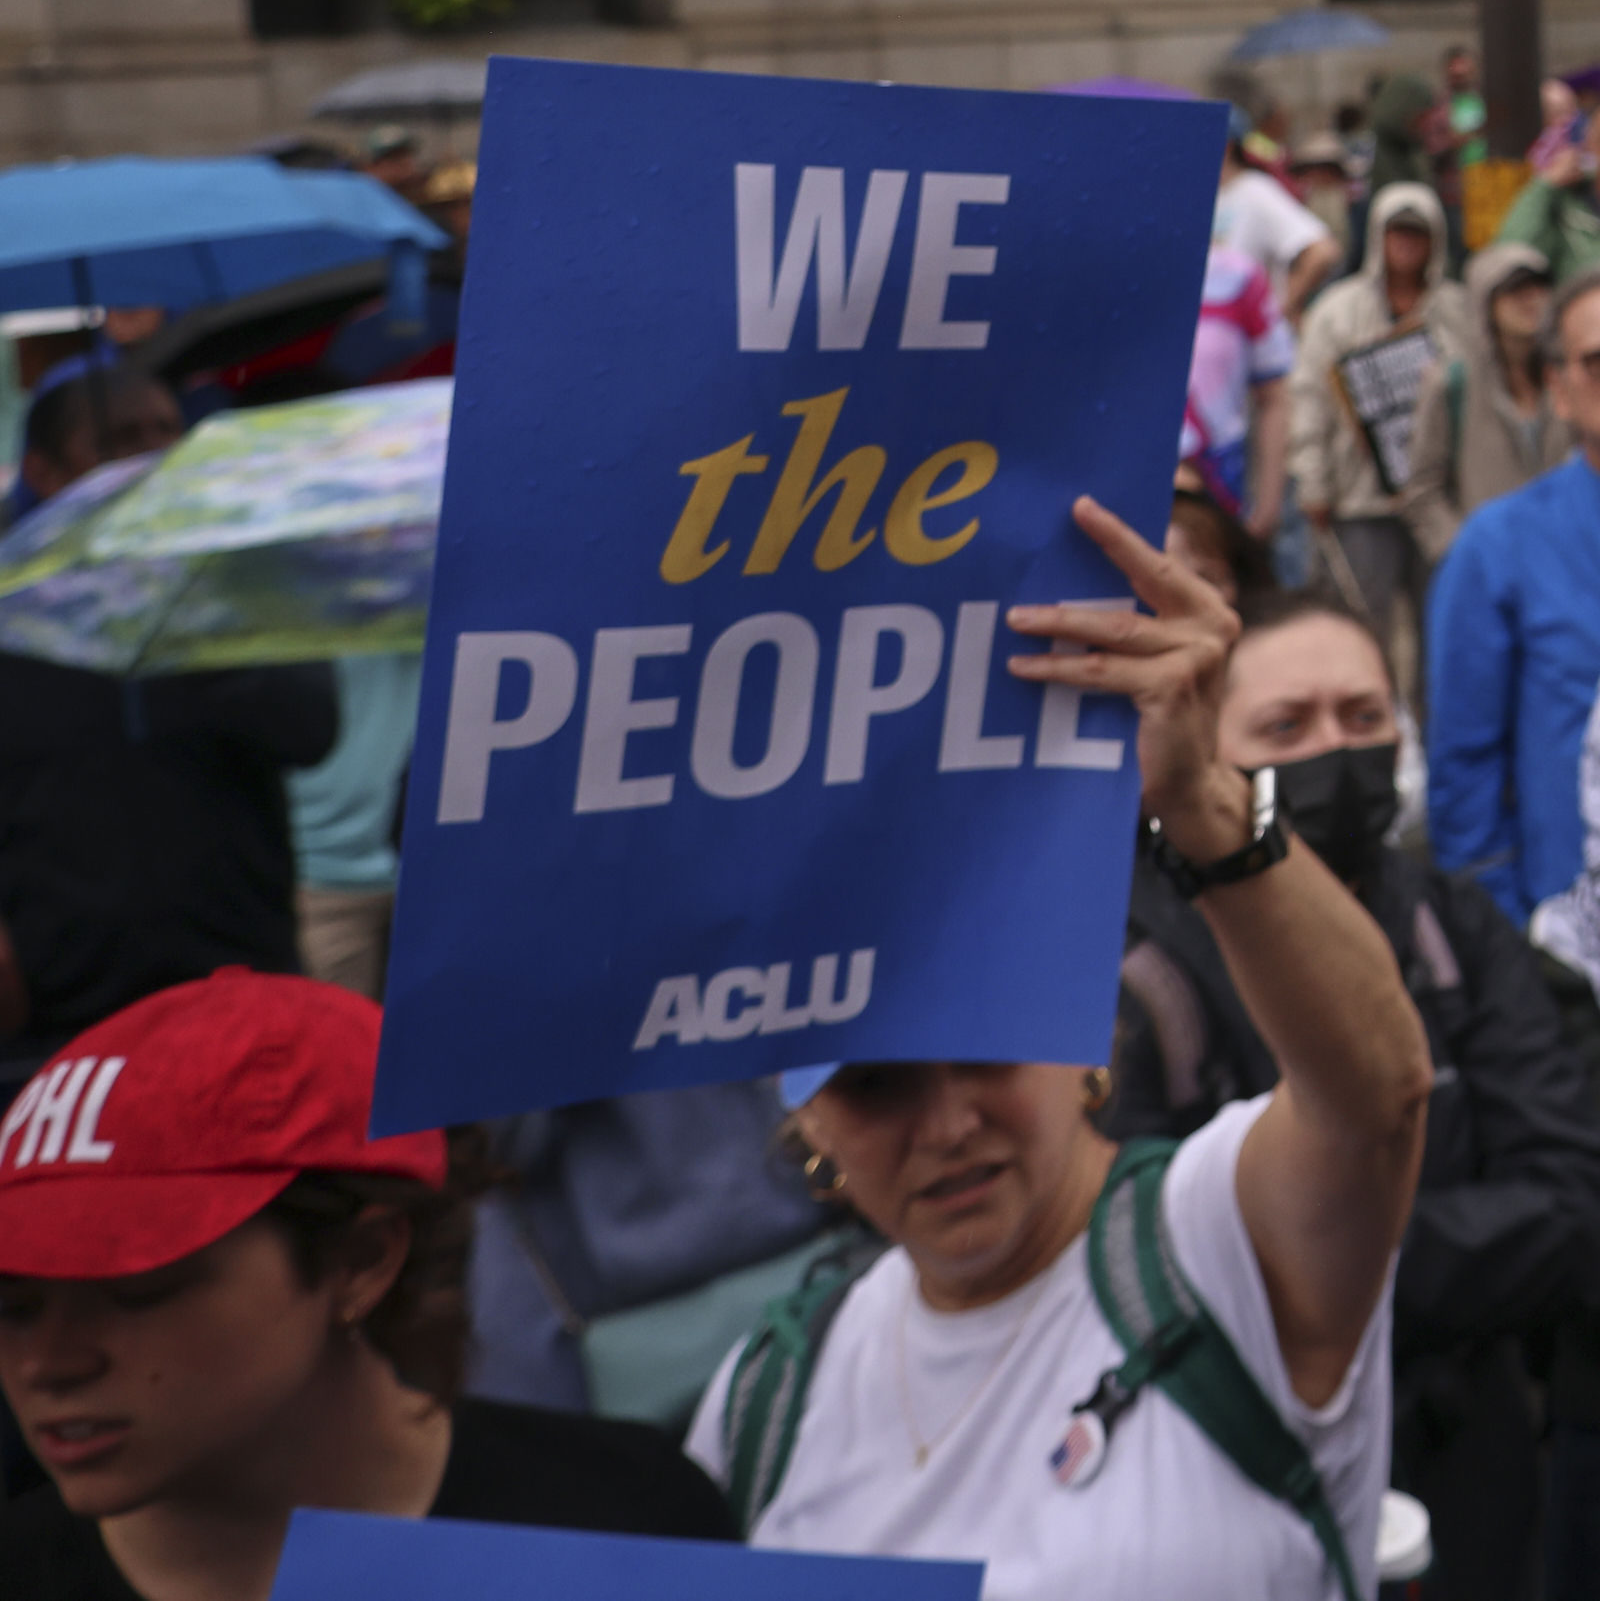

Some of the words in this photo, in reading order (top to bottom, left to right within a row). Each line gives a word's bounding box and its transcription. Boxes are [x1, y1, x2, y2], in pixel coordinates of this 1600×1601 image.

[734, 162, 1011, 352] WE
[659, 385, 999, 584] the
[436, 596, 1137, 824] PEOPLE
[631, 947, 877, 1052] ACLU
[0, 1054, 128, 1171] PHL
